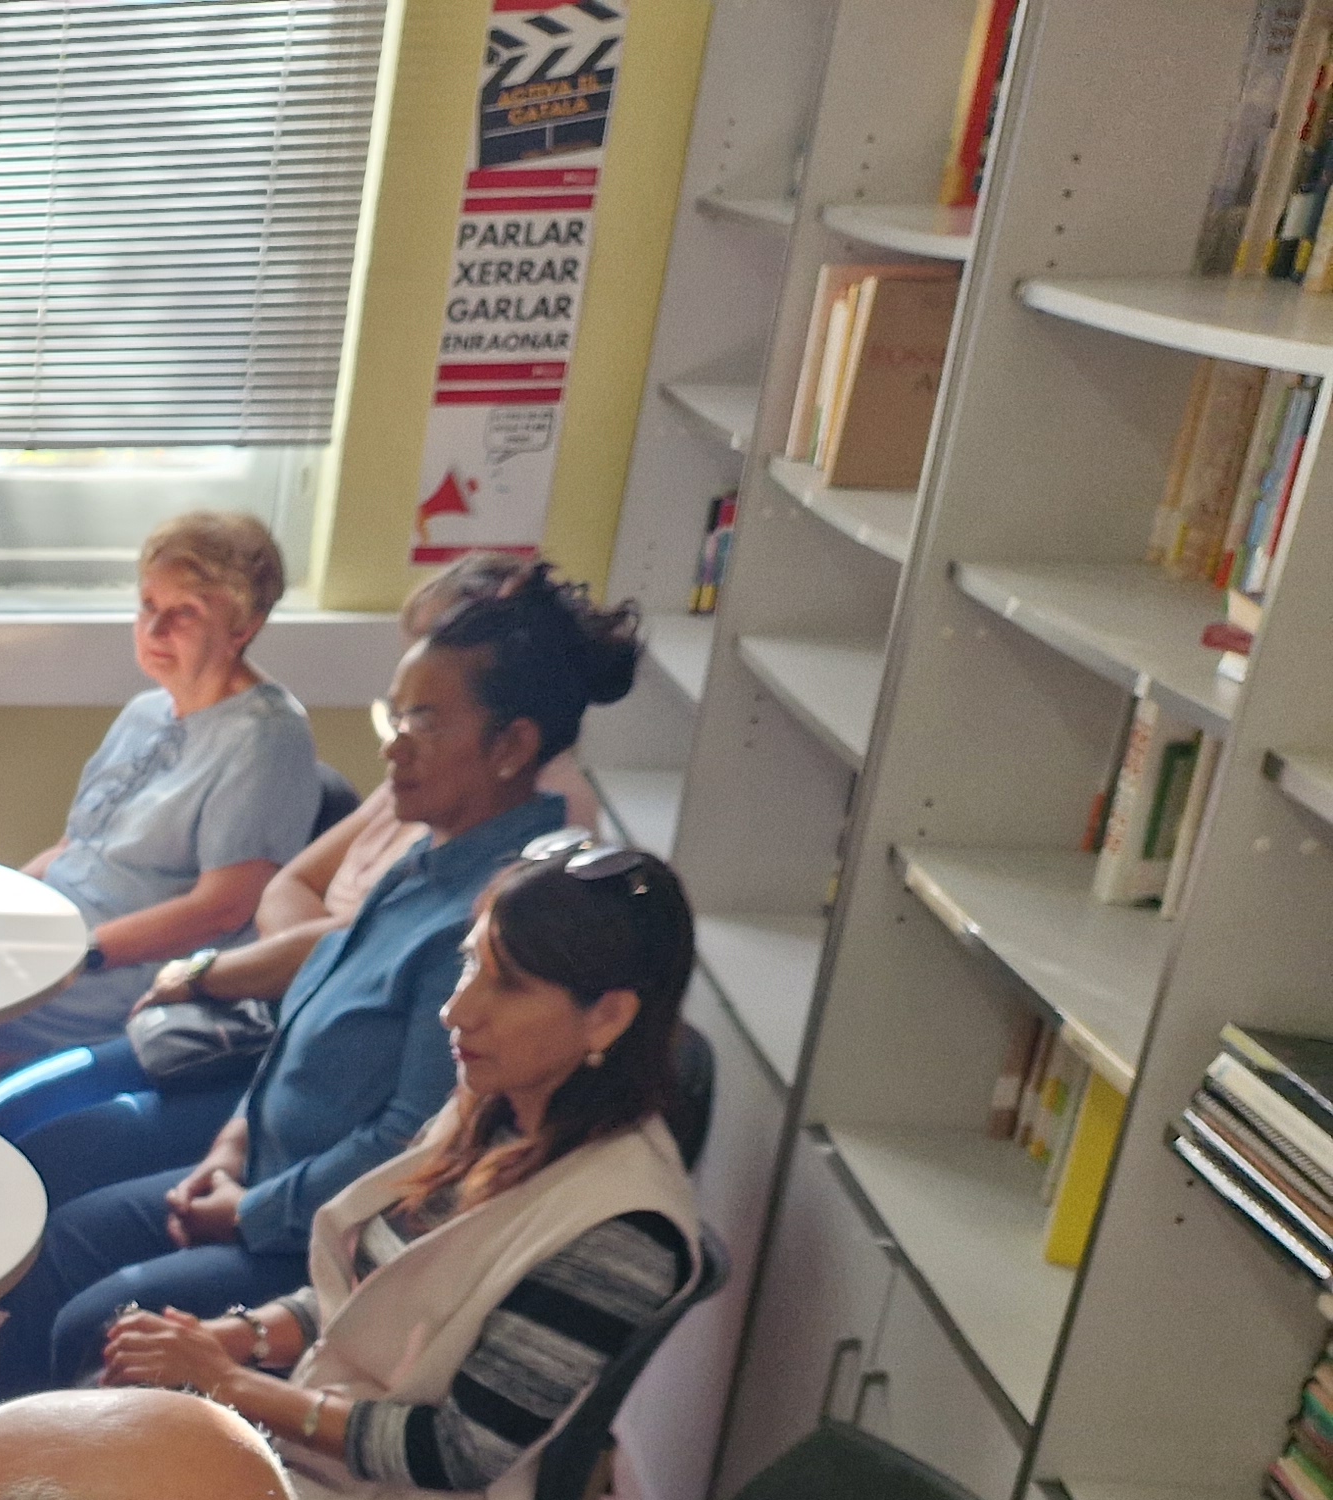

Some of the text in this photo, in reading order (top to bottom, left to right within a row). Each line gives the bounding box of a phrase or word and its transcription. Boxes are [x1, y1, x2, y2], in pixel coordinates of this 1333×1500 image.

[458, 219, 586, 248] PARLAR
[454, 257, 579, 286] XERRAR
[447, 294, 572, 324] GARLAR
[440, 332, 570, 353] ENRAONAR
